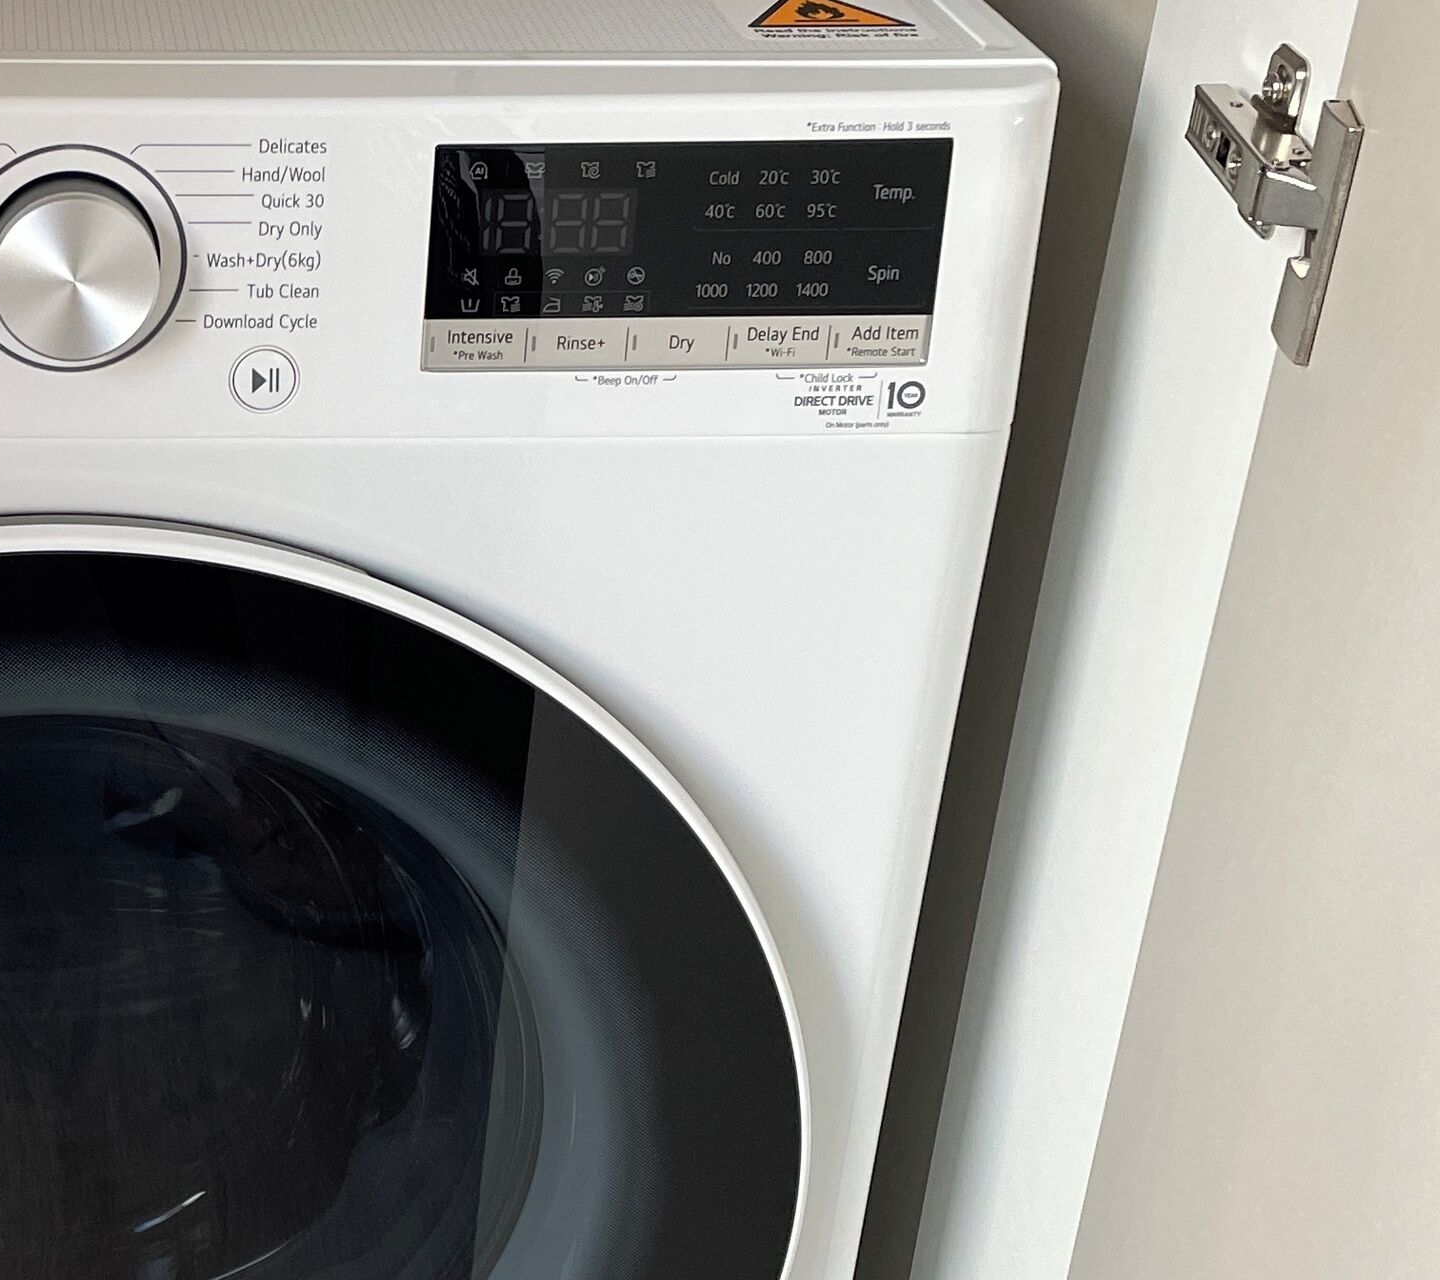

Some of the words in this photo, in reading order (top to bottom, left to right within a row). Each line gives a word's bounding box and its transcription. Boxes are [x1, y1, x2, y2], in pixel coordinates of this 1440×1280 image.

[883, 122, 904, 131] Hold
[907, 121, 914, 131] 3
[916, 121, 951, 131] seconds
[259, 138, 327, 154] Delicates
[242, 166, 326, 184] Hand/Wool
[710, 170, 740, 185] Cold
[261, 194, 300, 210] Quick
[305, 194, 325, 209] 30
[873, 184, 916, 204] Temp.
[259, 221, 284, 240] Dry
[289, 221, 322, 240] Only
[207, 250, 321, 271] Wash+Dry(6kg)
[712, 251, 731, 265] No
[752, 250, 782, 265] 400
[803, 250, 833, 264] 800
[868, 265, 900, 285] Spin
[247, 284, 274, 299] Tub
[279, 283, 319, 299] Clean
[695, 283, 728, 298] 1000
[745, 283, 778, 298] 1200
[796, 283, 829, 297] 1400
[203, 314, 274, 329] Download
[279, 314, 318, 333] Cycle
[447, 329, 513, 345] Intensive
[747, 327, 788, 345] Delay
[792, 326, 819, 341] End
[851, 326, 881, 341] Add
[886, 326, 919, 341] Item
[556, 335, 606, 351] Rinse+
[669, 335, 695, 353] Dry
[477, 350, 503, 361] Wash
[891, 346, 916, 357] Start
[624, 374, 658, 386] On/Off
[831, 373, 853, 384] Lock
[808, 384, 863, 392] INVERTER
[887, 381, 926, 409] 10
[794, 395, 836, 407] DIRECT
[838, 395, 874, 406] DRIVE
[818, 408, 847, 416] MOTOR
